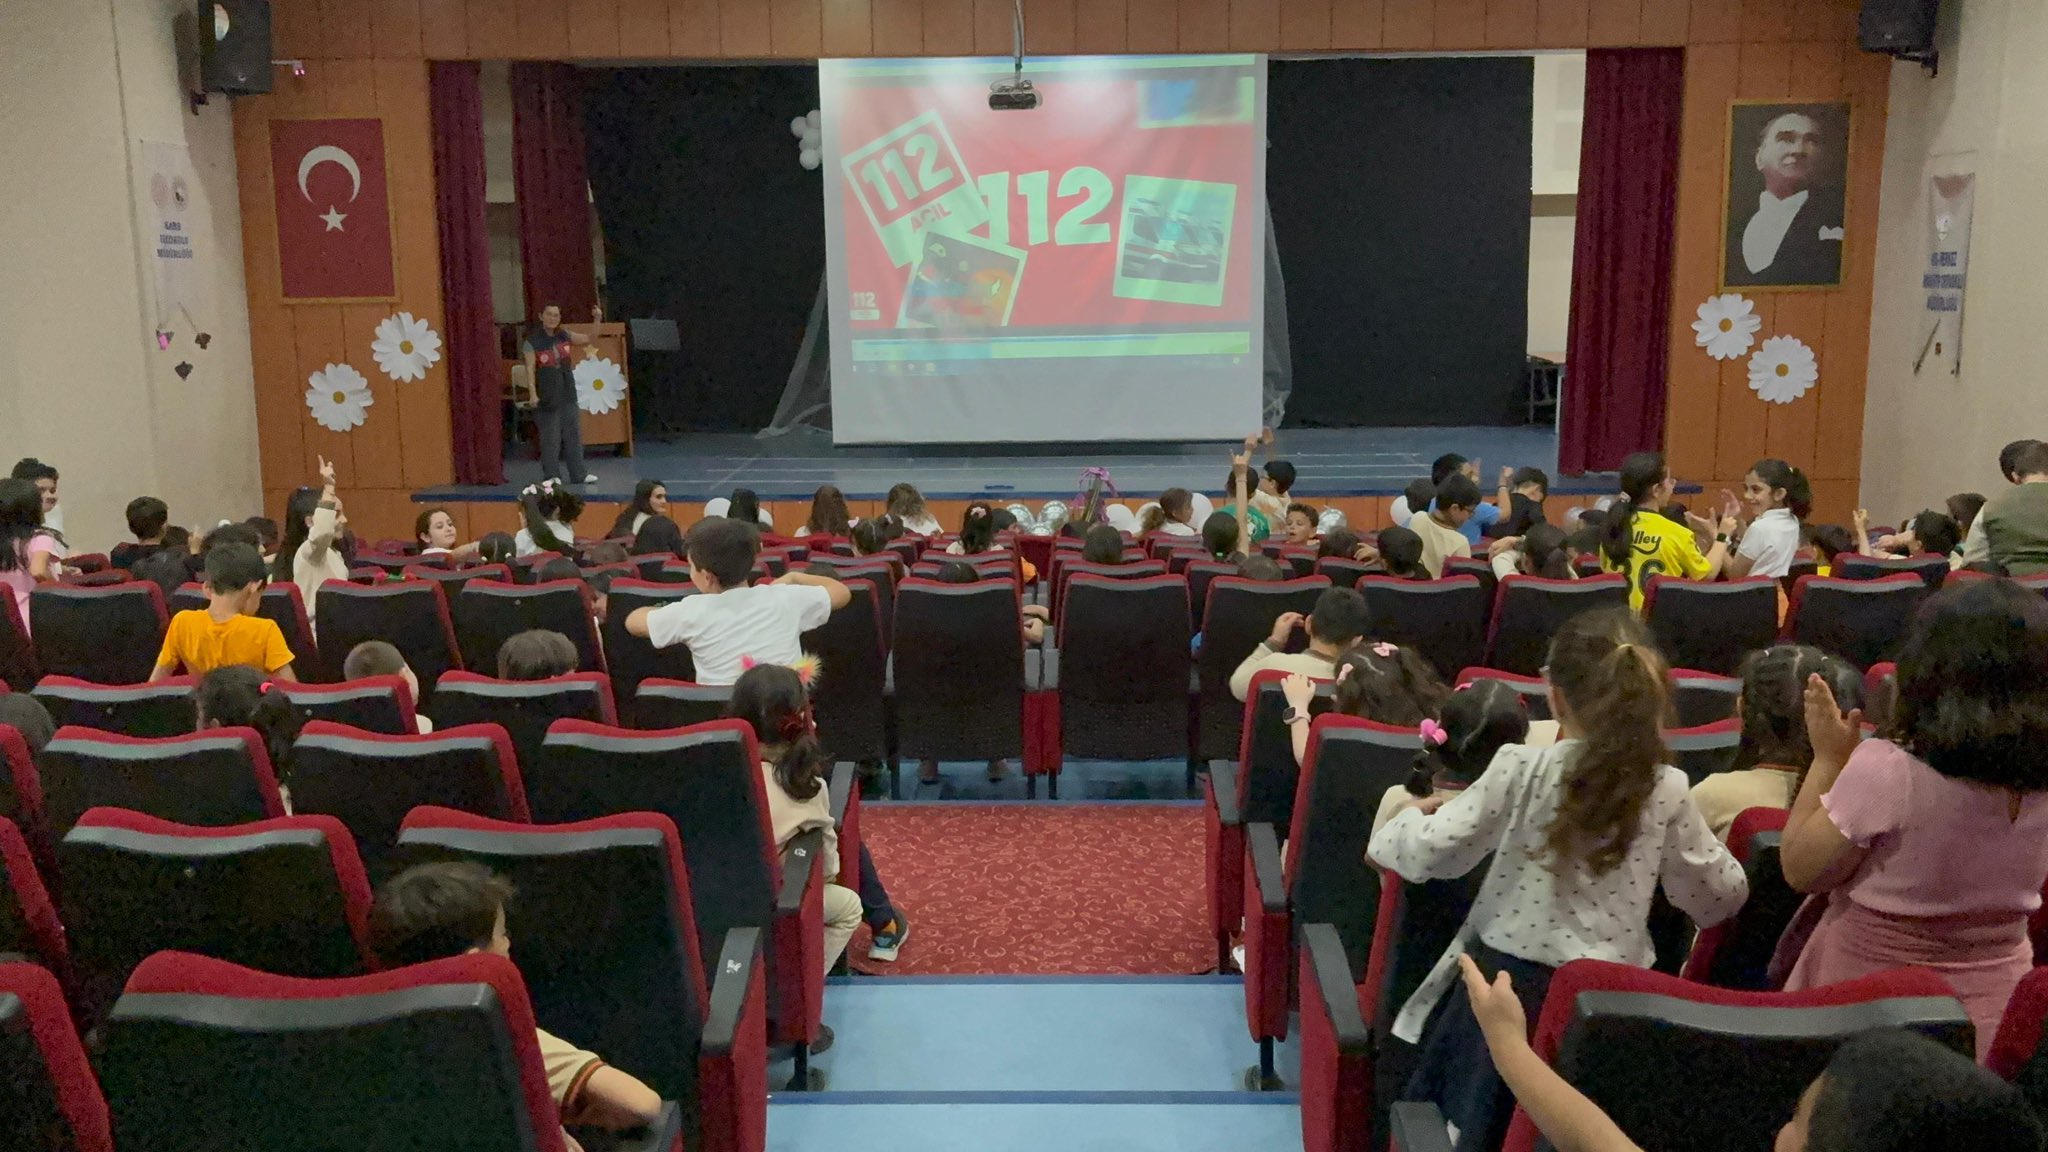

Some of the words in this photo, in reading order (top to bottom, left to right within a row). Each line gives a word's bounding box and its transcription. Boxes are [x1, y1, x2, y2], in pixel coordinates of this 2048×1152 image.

[861, 134, 953, 210] 112
[978, 166, 1113, 245] 112
[852, 291, 877, 308] 112
